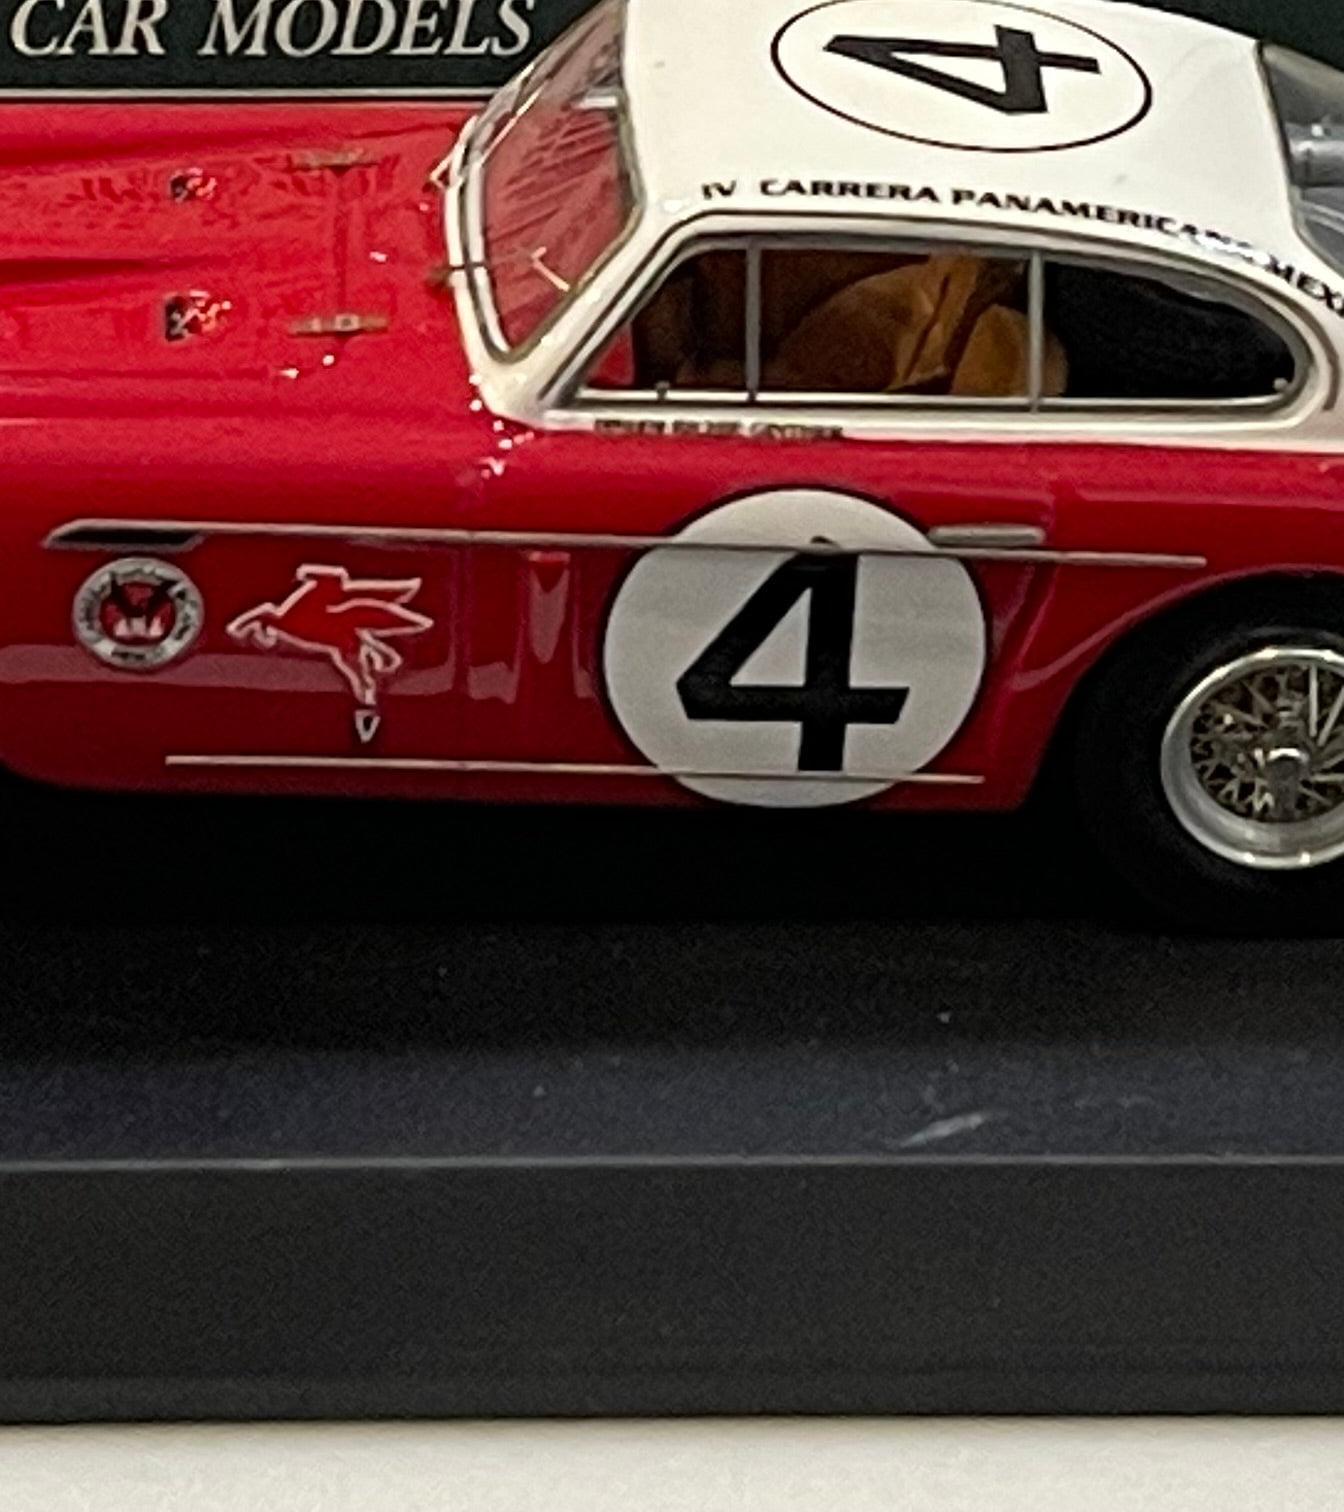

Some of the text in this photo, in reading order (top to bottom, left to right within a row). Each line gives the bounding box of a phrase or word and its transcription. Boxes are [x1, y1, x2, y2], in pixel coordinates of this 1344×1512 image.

[823, 23, 1101, 115] 4
[759, 178, 940, 205] CARRERA
[675, 550, 911, 773] 4
